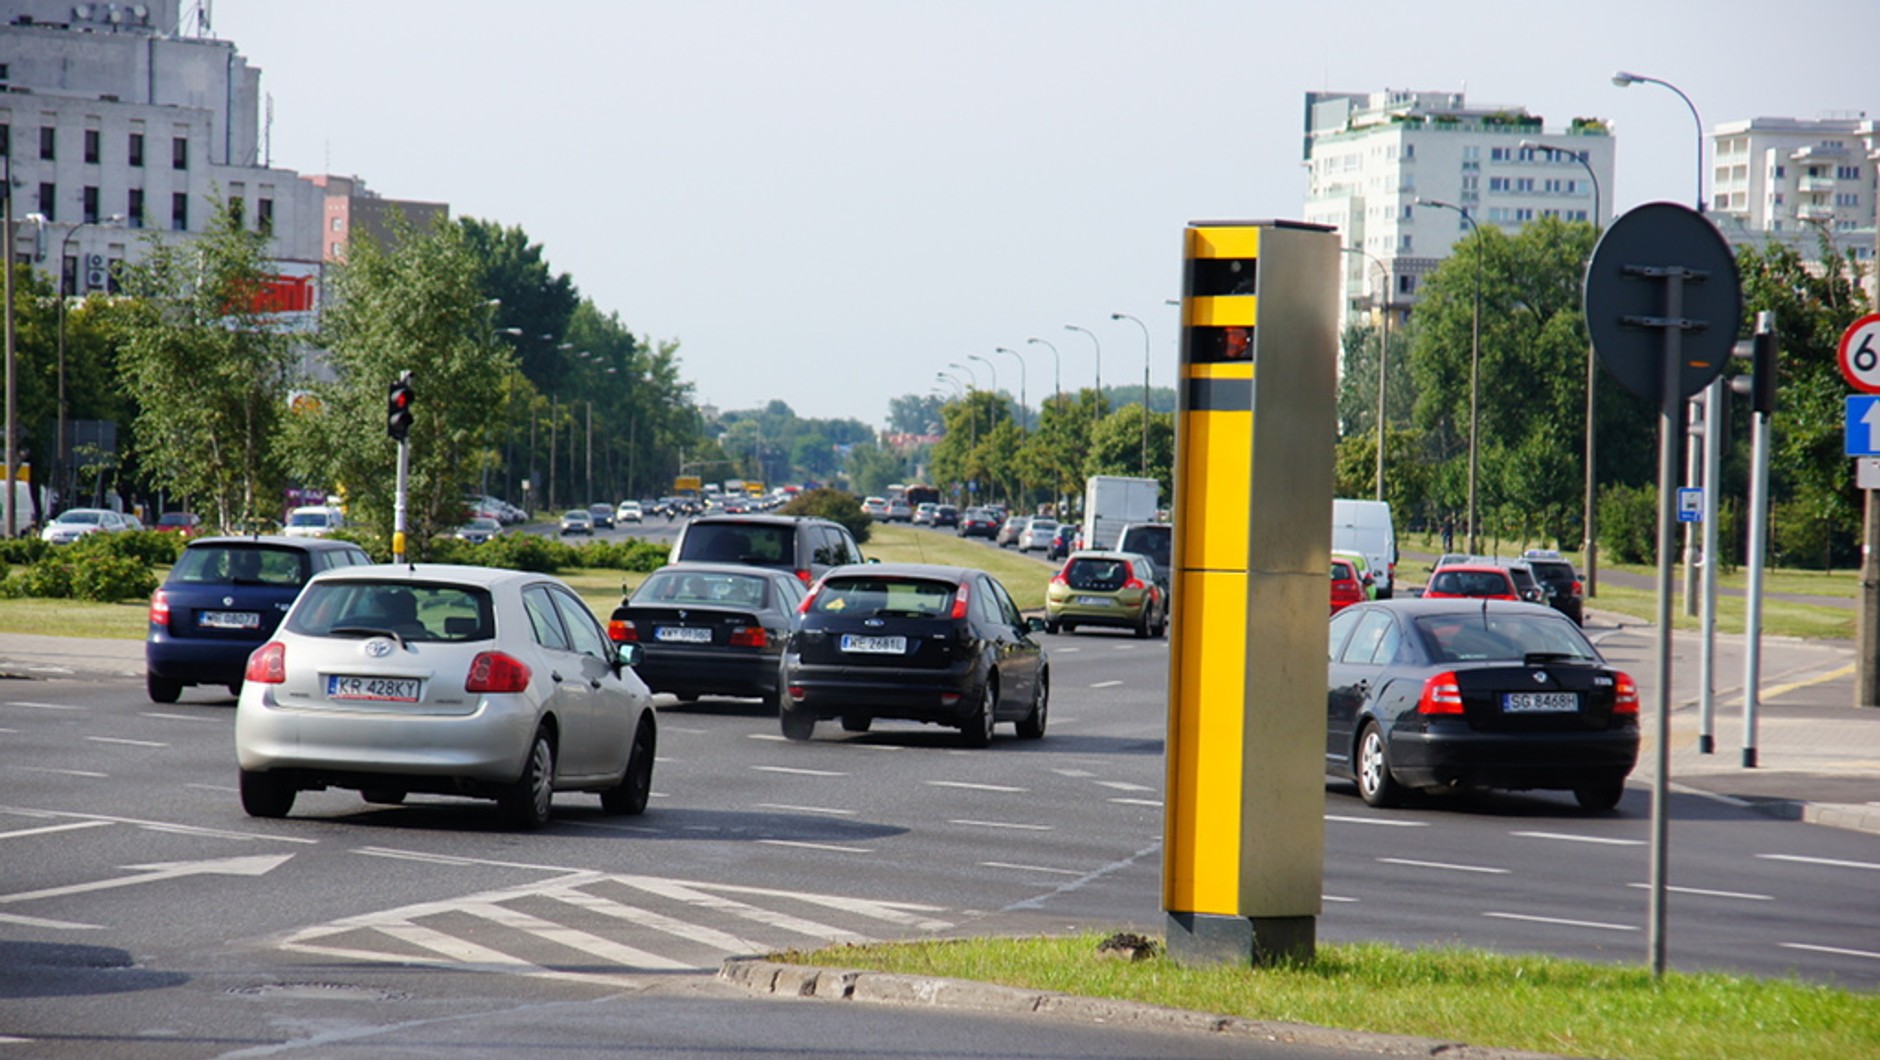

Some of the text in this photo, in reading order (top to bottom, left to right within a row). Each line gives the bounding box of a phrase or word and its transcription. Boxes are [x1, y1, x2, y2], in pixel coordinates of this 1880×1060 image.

[338, 678, 417, 697] KR 428KY
[1510, 694, 1576, 708] SG 8468H
